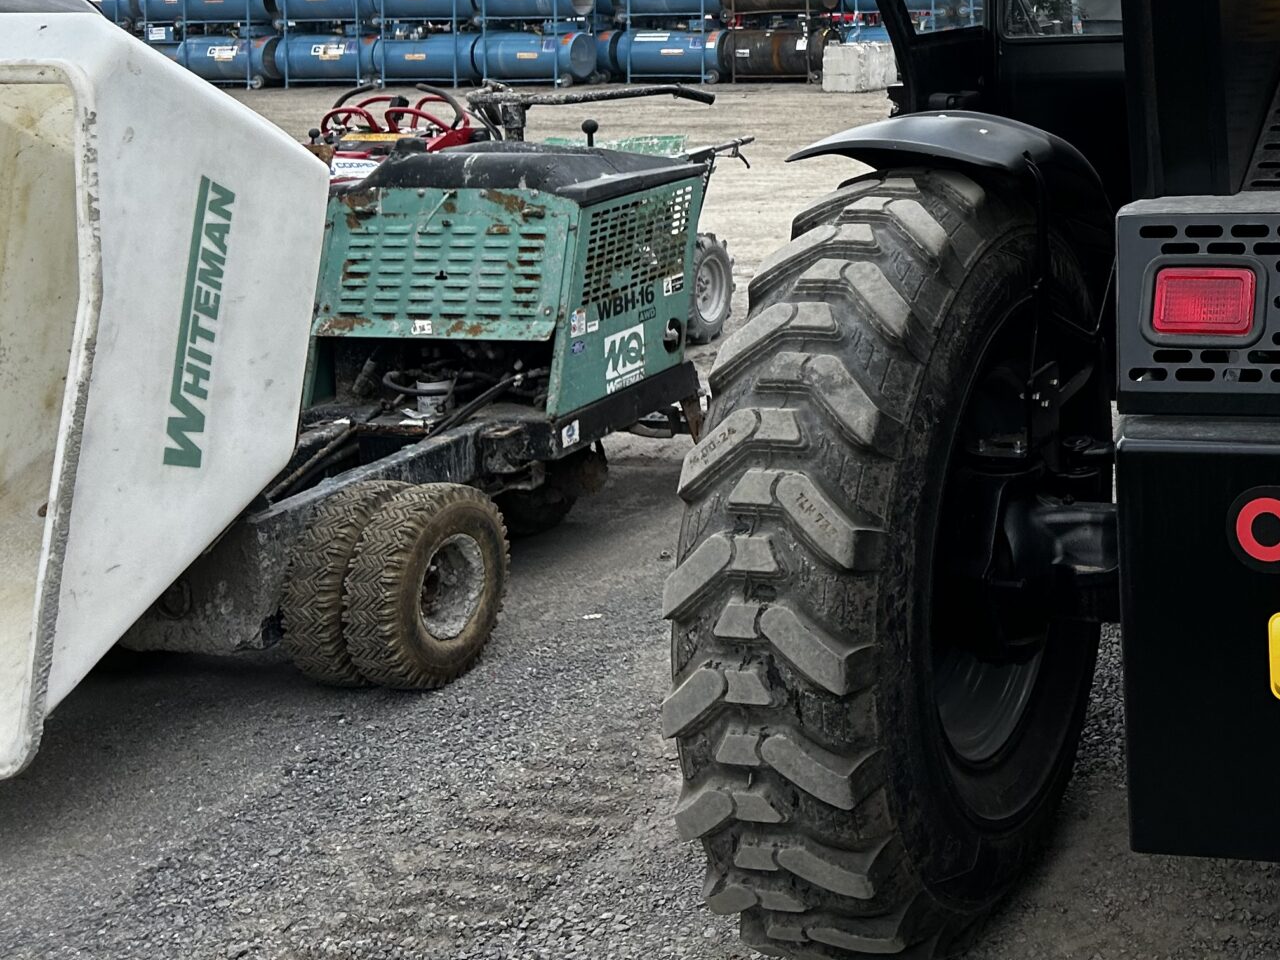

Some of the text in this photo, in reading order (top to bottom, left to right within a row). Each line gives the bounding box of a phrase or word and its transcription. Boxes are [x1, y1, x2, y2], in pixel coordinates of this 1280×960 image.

[162, 174, 236, 469] WHITEMAN
[597, 283, 655, 321] WBH-16
[639, 307, 656, 322] AWD
[604, 326, 645, 377] MQ
